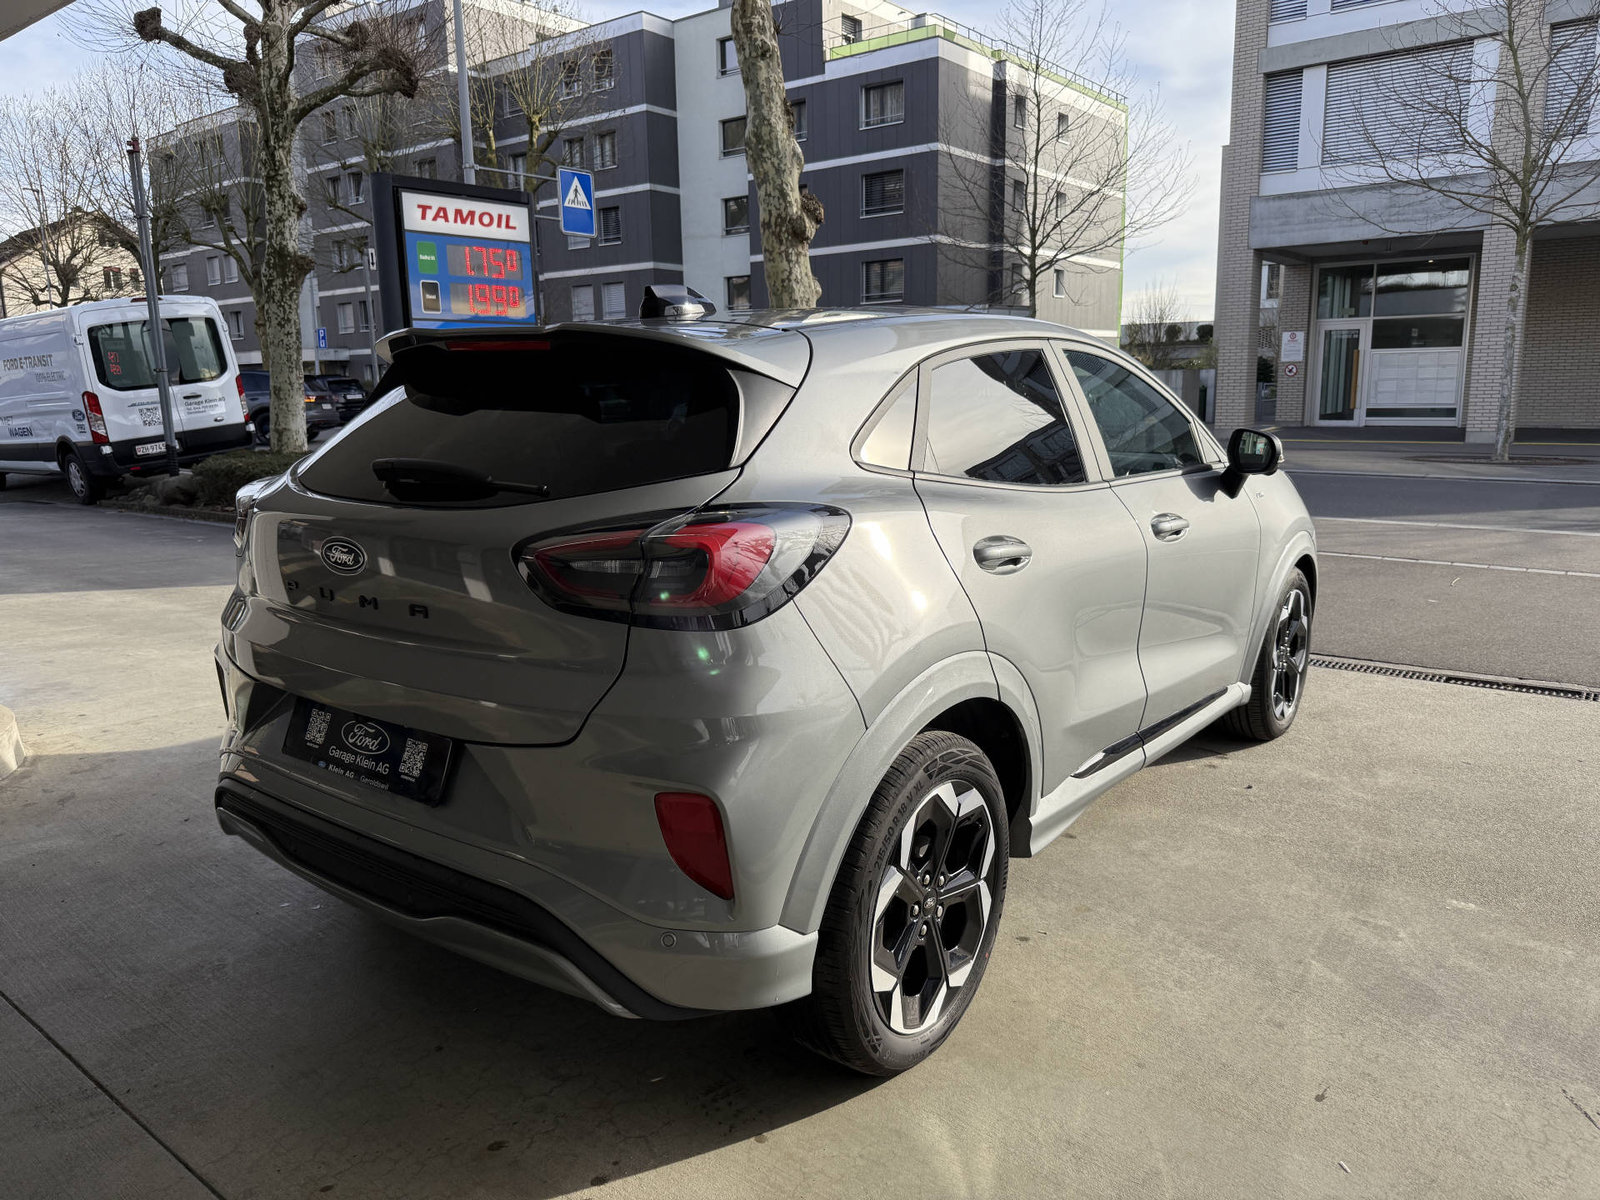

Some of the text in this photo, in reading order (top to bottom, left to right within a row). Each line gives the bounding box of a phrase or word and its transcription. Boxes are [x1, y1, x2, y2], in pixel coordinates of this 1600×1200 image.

[416, 203, 518, 230] TAMOIL
[3, 354, 53, 371] FORD E-TRANSIT
[8, 426, 33, 437] WAGEN
[326, 545, 356, 566] Ford
[287, 580, 429, 619] PUMA
[349, 723, 382, 751] Ford
[328, 745, 355, 764] Garage
[355, 755, 376, 772] Klein
[376, 761, 390, 775] AG
[328, 763, 345, 776] Klein
[345, 769, 355, 779] AG
[874, 826, 896, 869] 215/50
[898, 802, 908, 816] 18
[906, 791, 913, 801] V
[914, 780, 924, 793] XL
